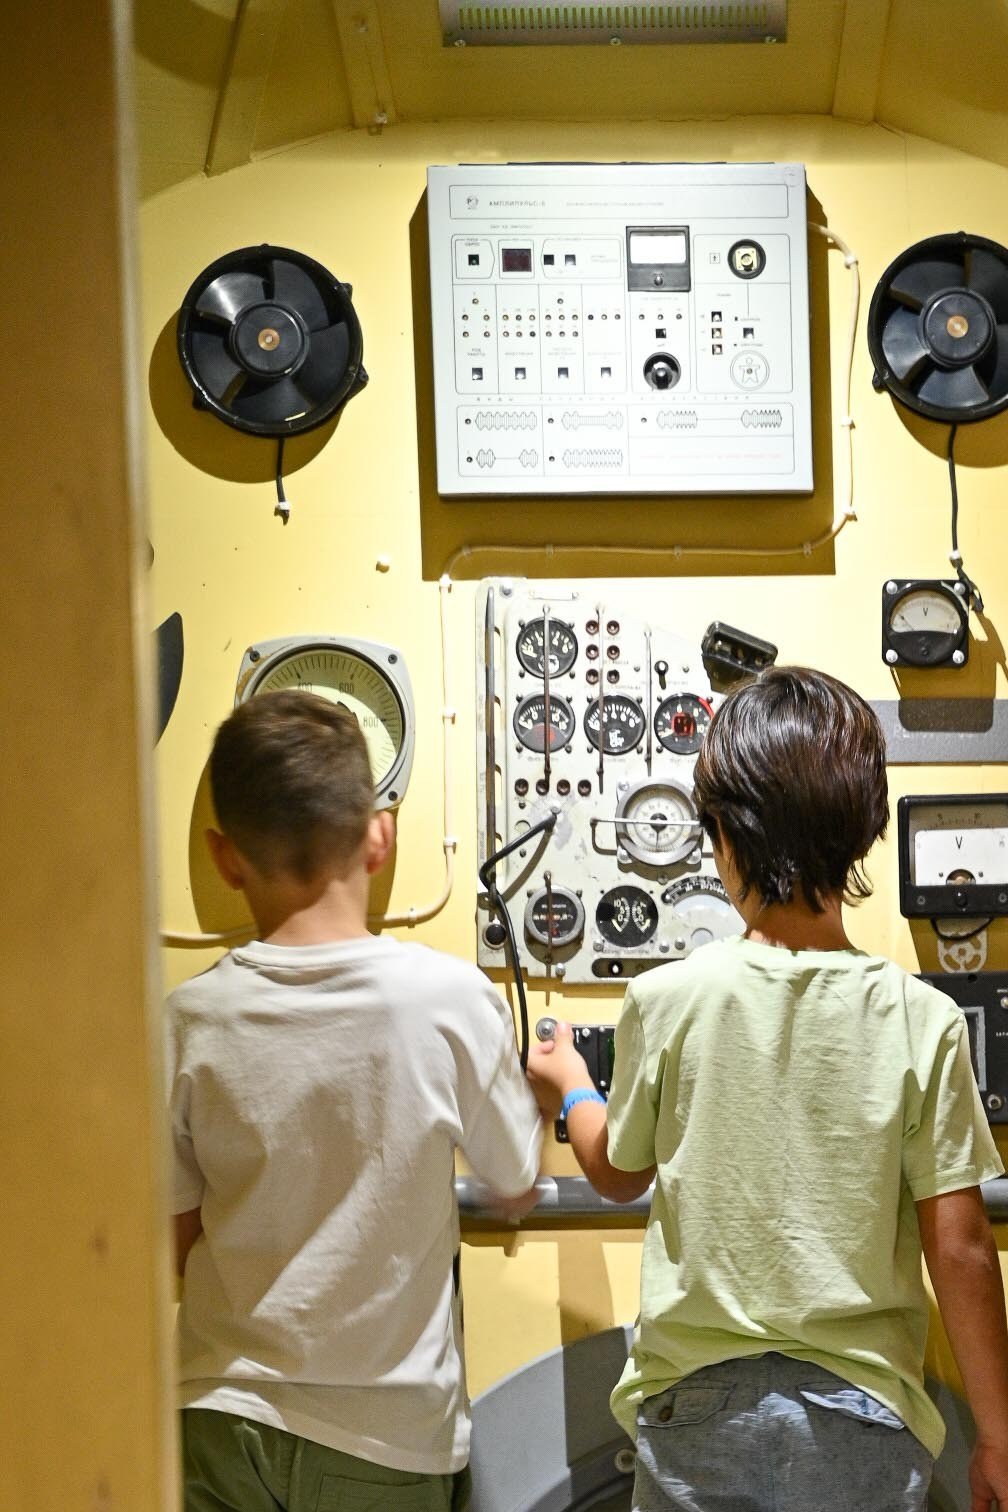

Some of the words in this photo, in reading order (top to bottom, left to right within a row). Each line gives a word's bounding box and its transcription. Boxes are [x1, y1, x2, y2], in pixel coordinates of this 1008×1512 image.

[923, 608, 929, 616] V
[955, 836, 963, 849] V
[613, 899, 622, 907] 10
